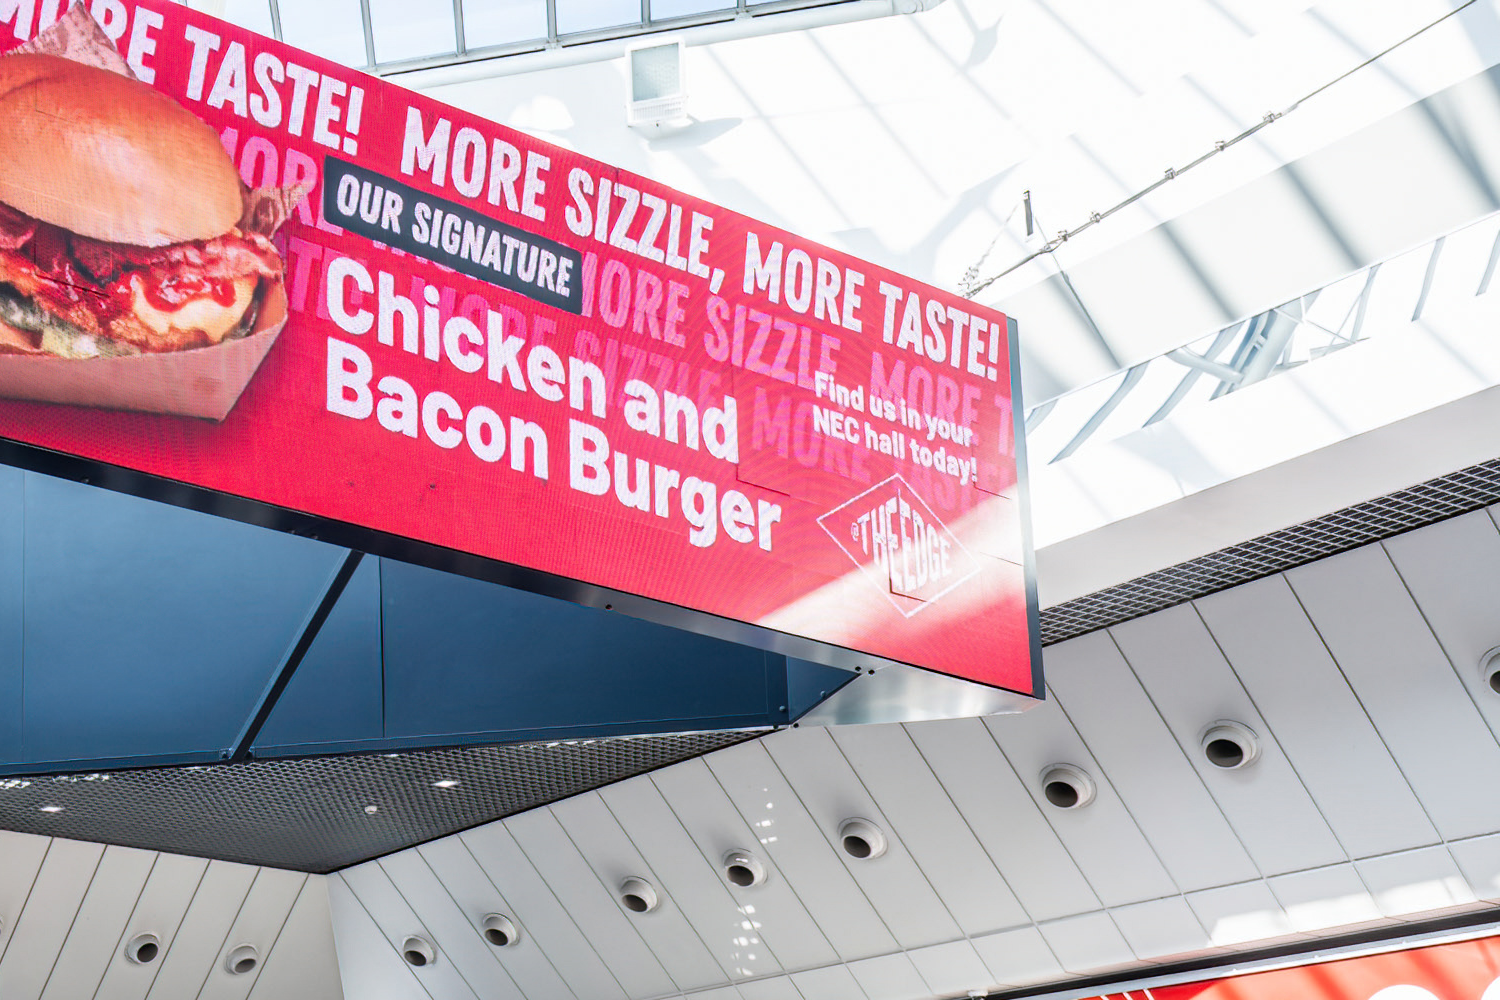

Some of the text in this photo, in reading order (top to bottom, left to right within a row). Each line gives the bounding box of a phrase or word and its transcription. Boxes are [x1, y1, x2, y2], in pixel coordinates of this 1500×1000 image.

[185, 24, 365, 156] TASTE!
[401, 106, 550, 222] MORE
[565, 167, 726, 295] SIZZLE,
[743, 231, 865, 333] MORE
[879, 280, 1000, 382] TASTE!
[336, 173, 404, 234] OUR
[412, 201, 574, 298] SIGNATURE
[327, 257, 607, 418] Chicken
[623, 379, 739, 463] and
[814, 370, 865, 413] Find
[869, 395, 897, 422] us
[900, 397, 921, 430] in
[925, 412, 973, 448] your
[326, 337, 549, 480] Bacon
[569, 418, 782, 551] Burger
[812, 404, 861, 444] NEC
[864, 421, 905, 460] hall
[910, 438, 978, 486] today!
